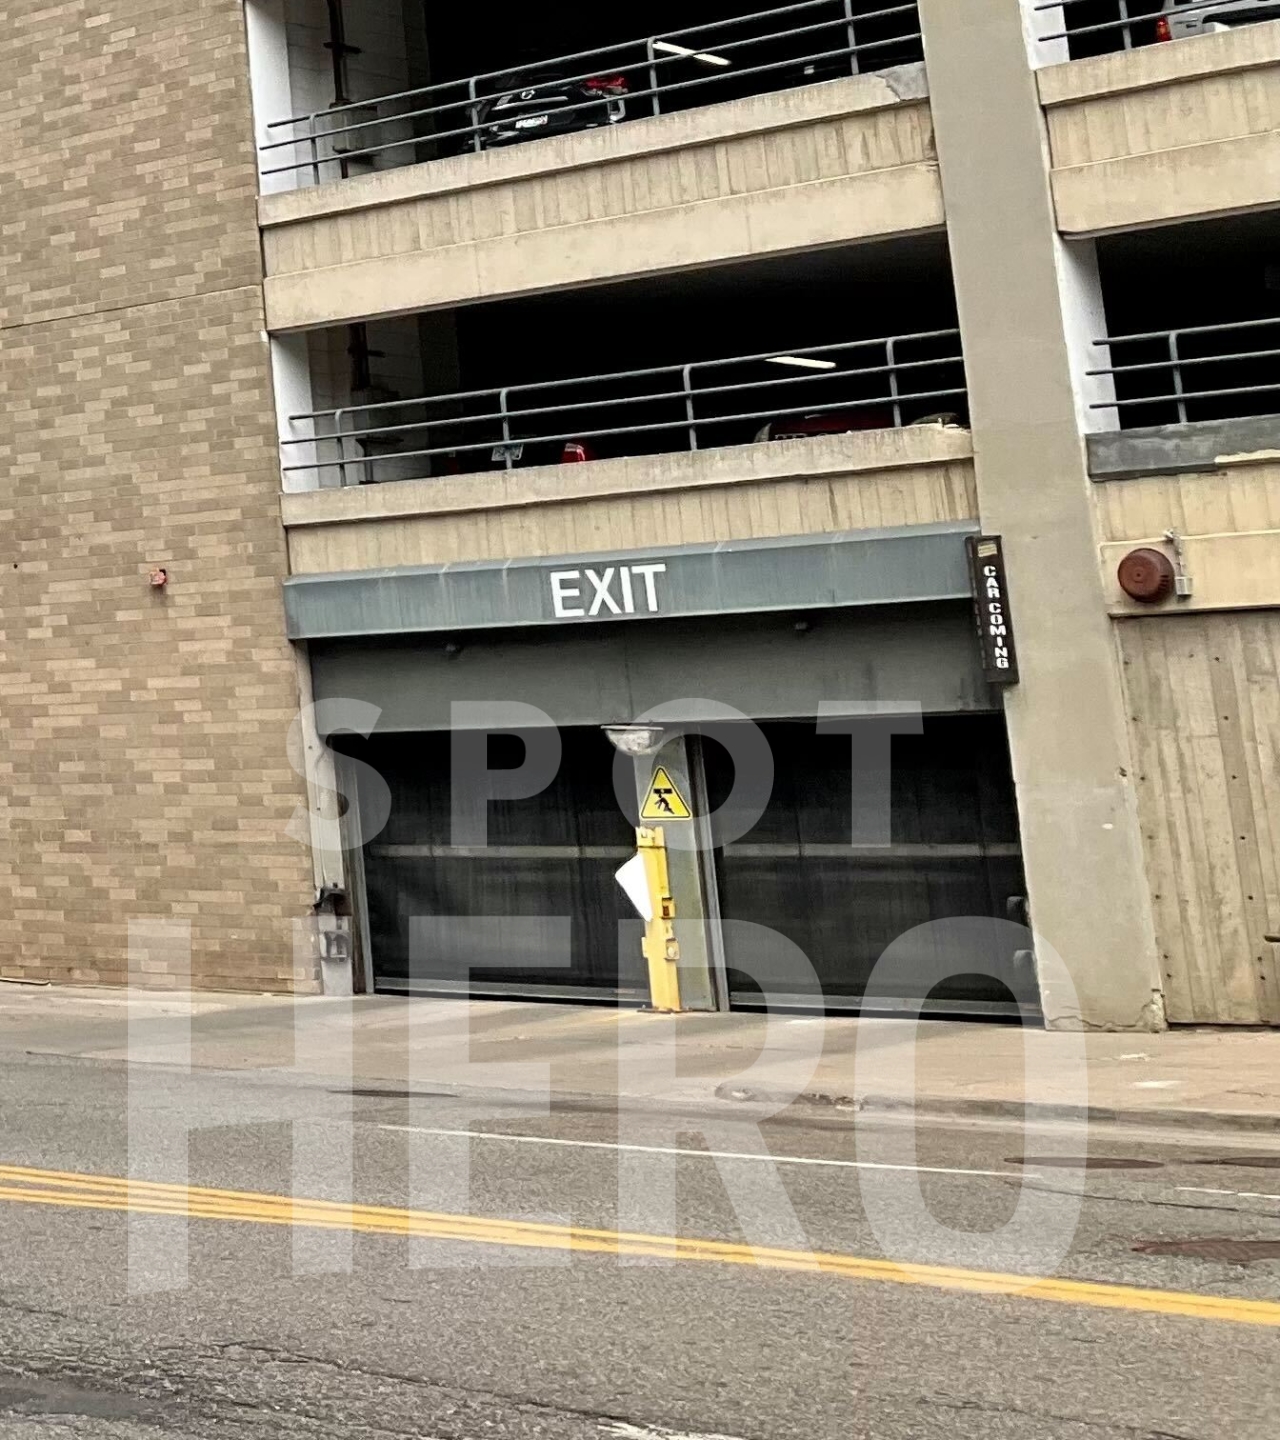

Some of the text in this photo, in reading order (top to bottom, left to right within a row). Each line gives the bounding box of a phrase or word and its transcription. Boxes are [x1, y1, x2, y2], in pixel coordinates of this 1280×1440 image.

[550, 563, 666, 618] EXIT
[983, 565, 1000, 598] CAR
[989, 602, 1009, 669] COMING
